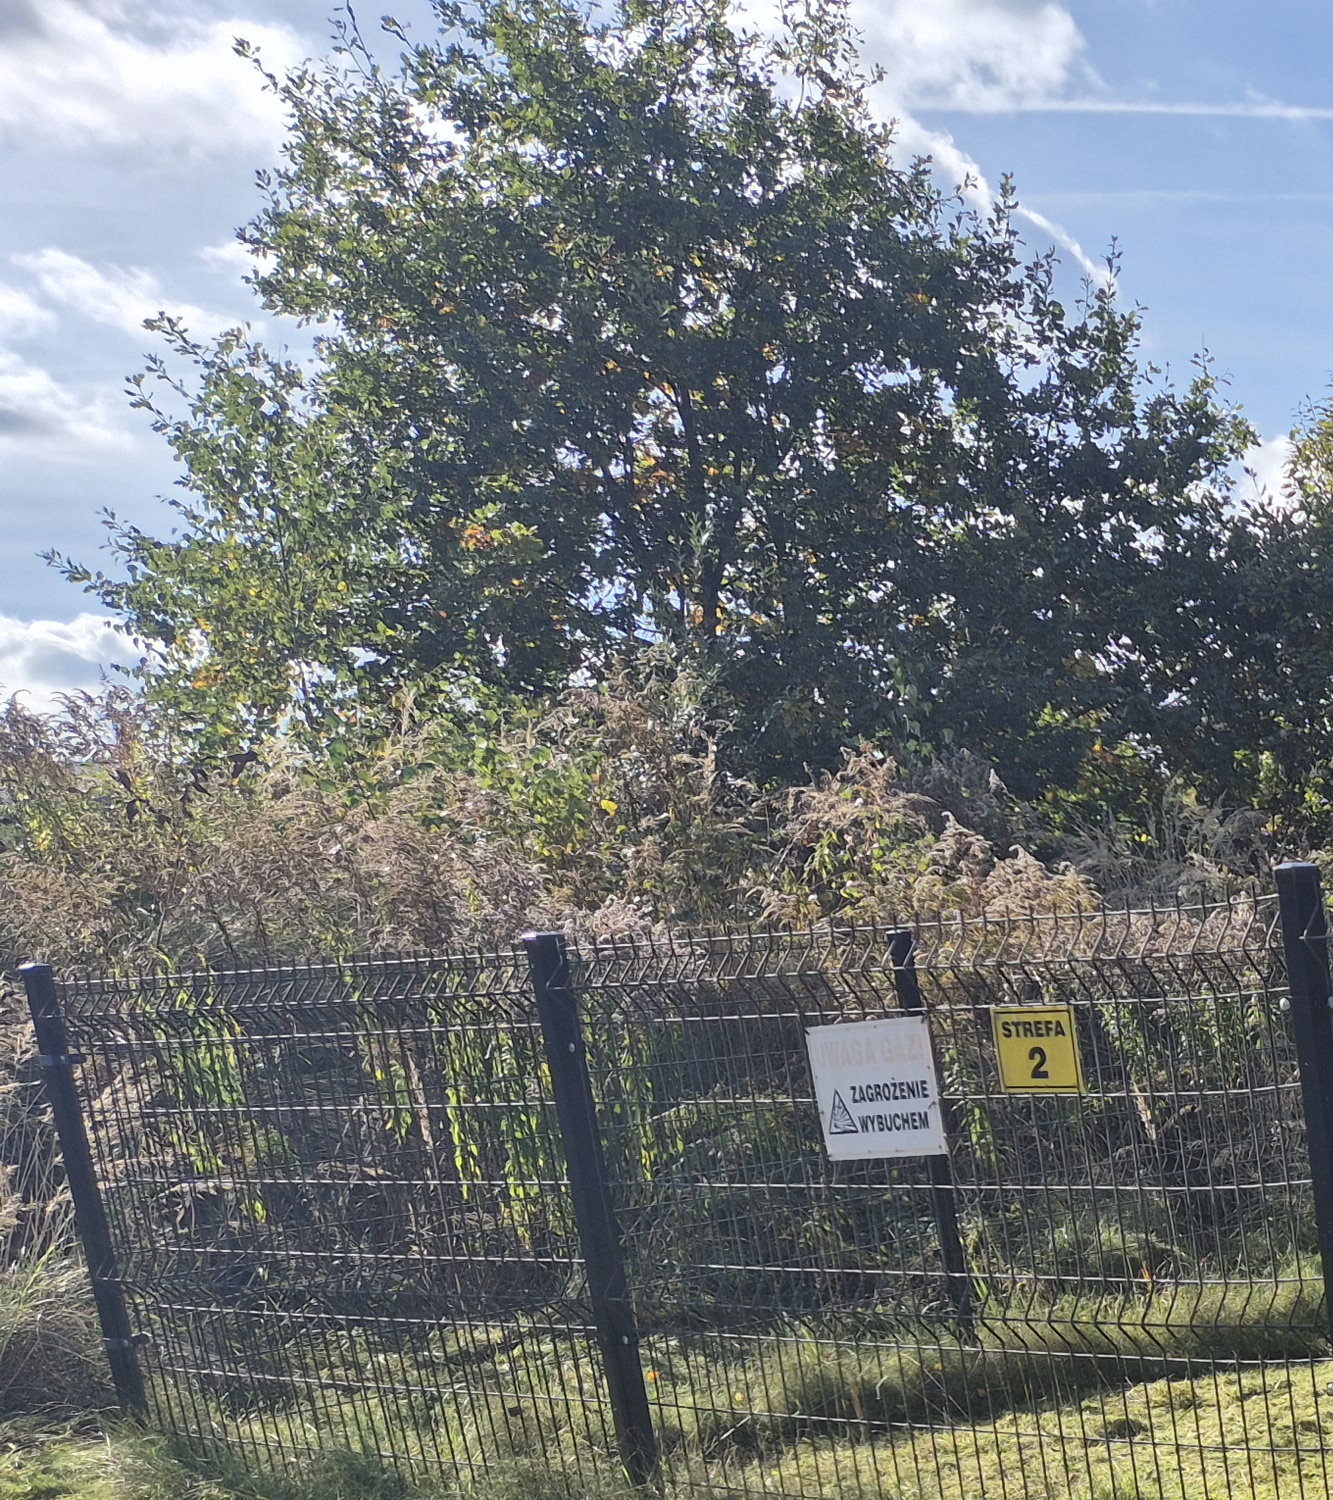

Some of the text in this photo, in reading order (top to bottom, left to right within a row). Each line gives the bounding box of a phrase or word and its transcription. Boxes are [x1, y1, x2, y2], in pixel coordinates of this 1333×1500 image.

[1001, 1020, 1066, 1038] STREFA
[817, 1037, 878, 1068] UWAGA
[1028, 1046, 1049, 1079] 2
[849, 1077, 930, 1104] ZAGROŻENIE
[857, 1111, 930, 1133] WYBUCHEM
